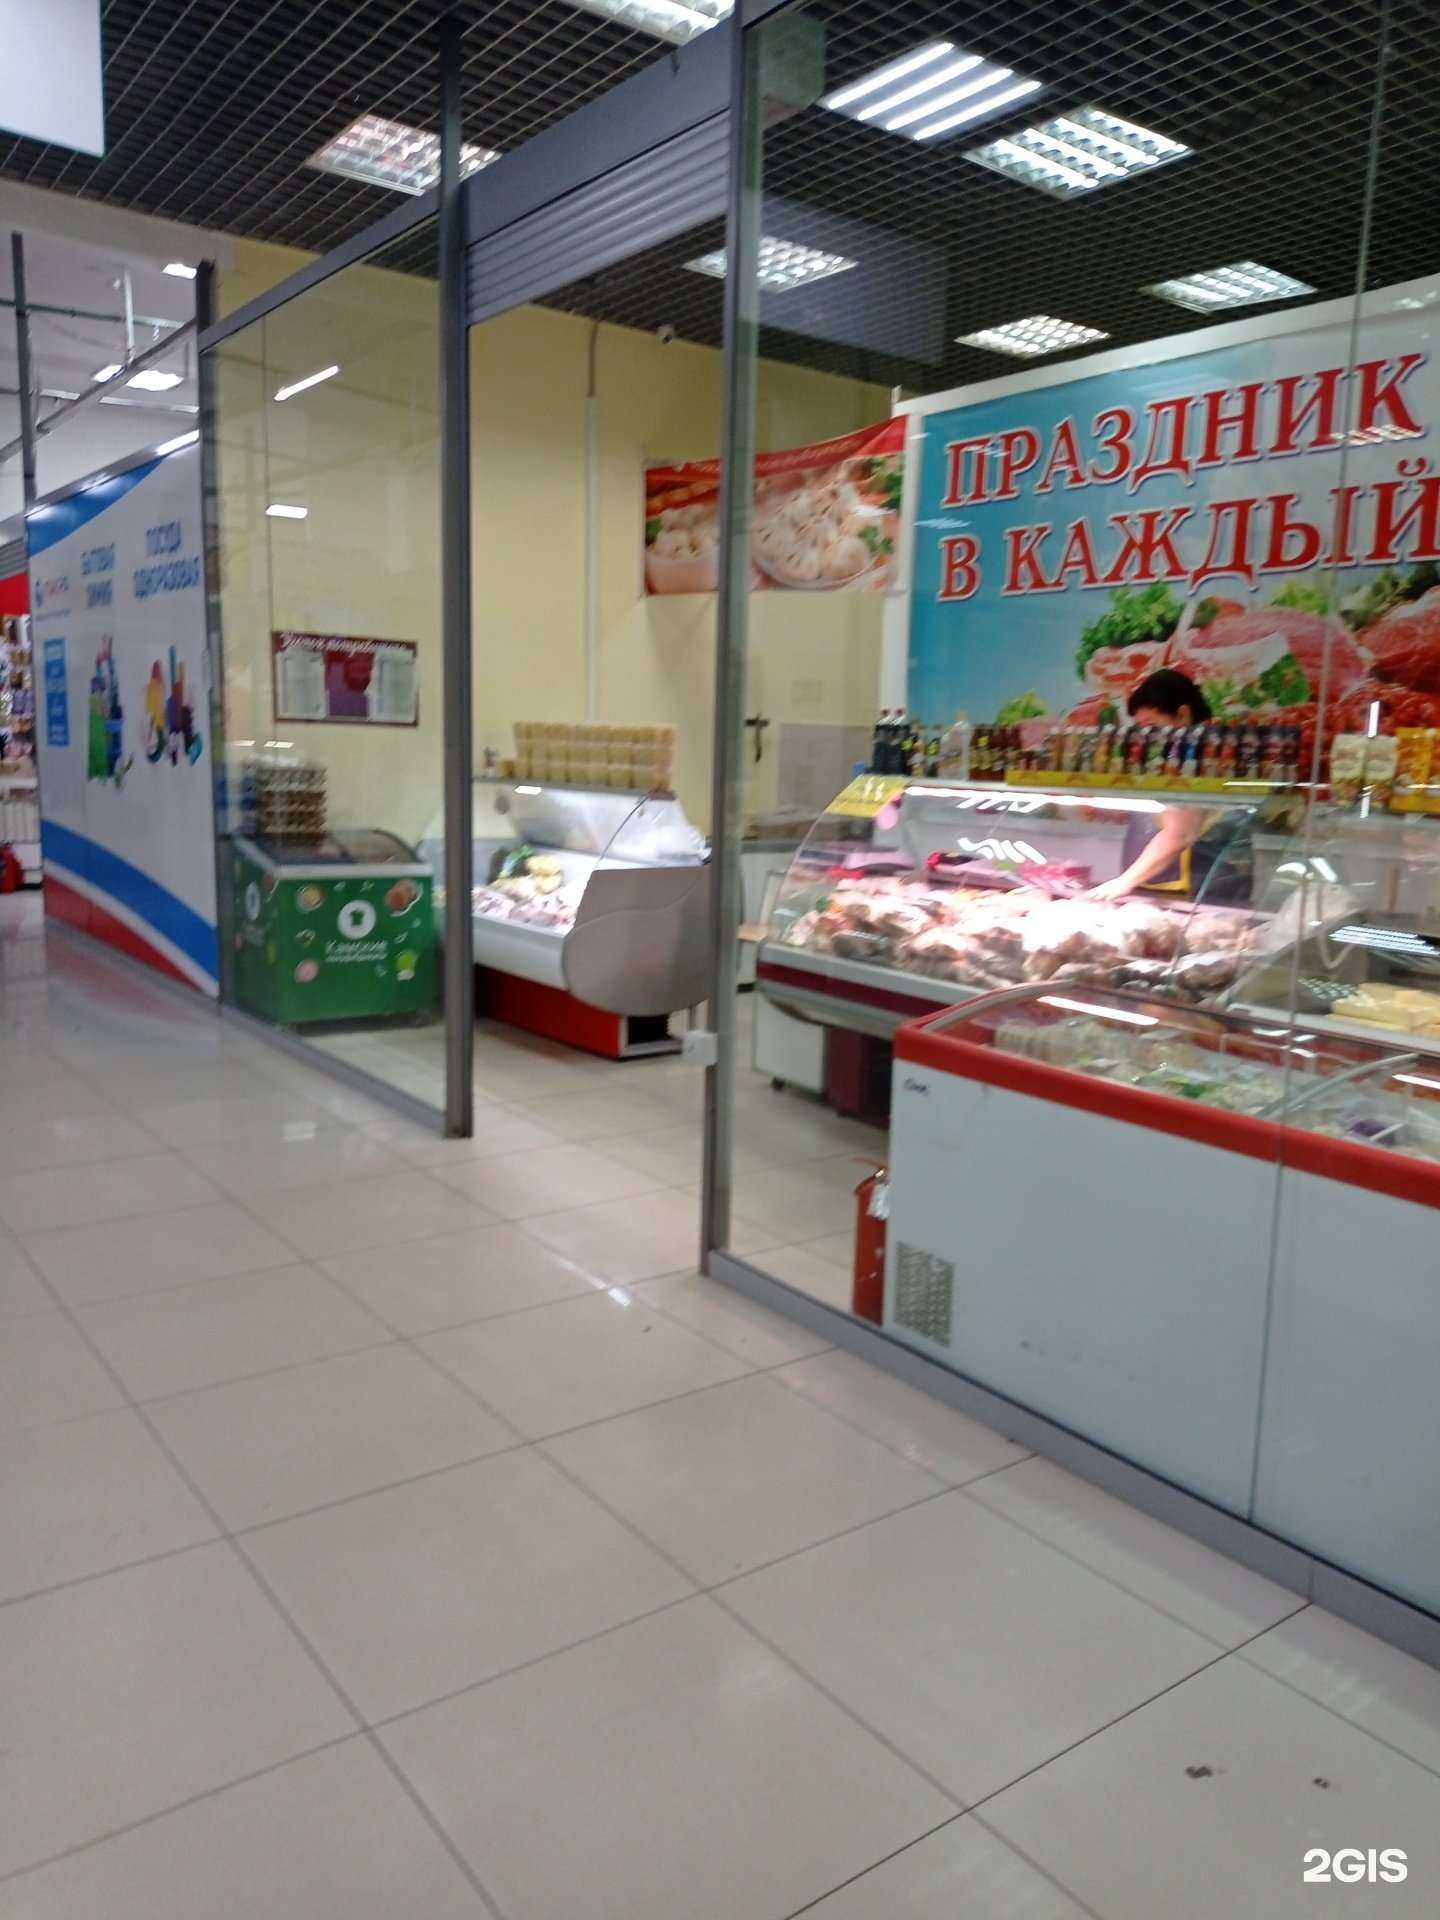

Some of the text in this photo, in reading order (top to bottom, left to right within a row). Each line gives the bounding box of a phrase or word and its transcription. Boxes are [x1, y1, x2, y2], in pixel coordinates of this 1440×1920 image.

[940, 353, 1426, 508] ПРАЗДНИК
[938, 457, 1440, 601] В КАЖДЫЙ
